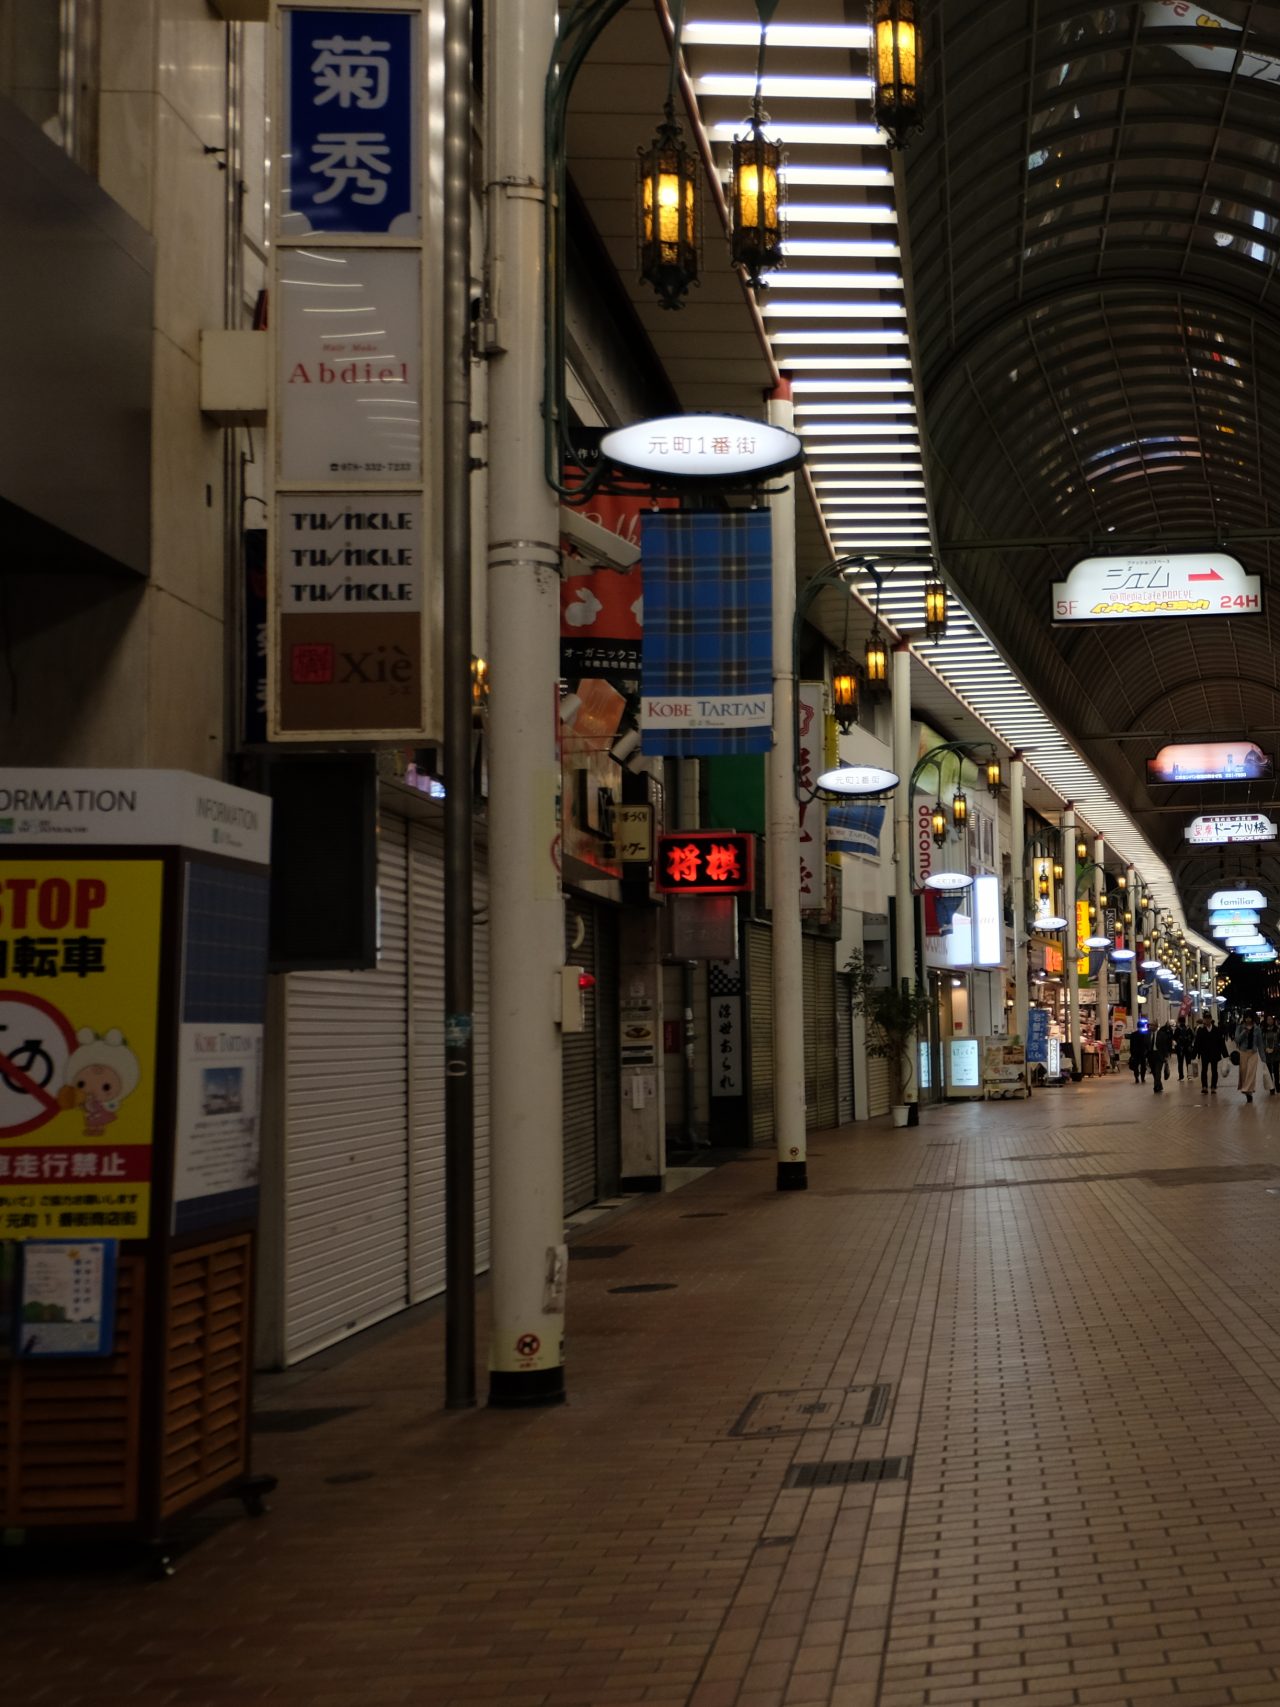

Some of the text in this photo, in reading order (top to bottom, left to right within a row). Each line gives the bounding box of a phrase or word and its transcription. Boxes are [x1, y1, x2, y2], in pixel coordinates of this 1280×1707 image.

[309, 35, 392, 205] 菊秀
[288, 363, 409, 384] Abdiel
[648, 436, 757, 455] 元町1番街
[1056, 601, 1079, 615] 5F
[1220, 595, 1258, 609] 24H
[564, 648, 642, 659] オーガニックコ
[648, 701, 766, 717] KOBE TARTAN
[918, 805, 932, 881] docomo
[666, 843, 742, 882] 将棋
[0, 878, 106, 929] TOP
